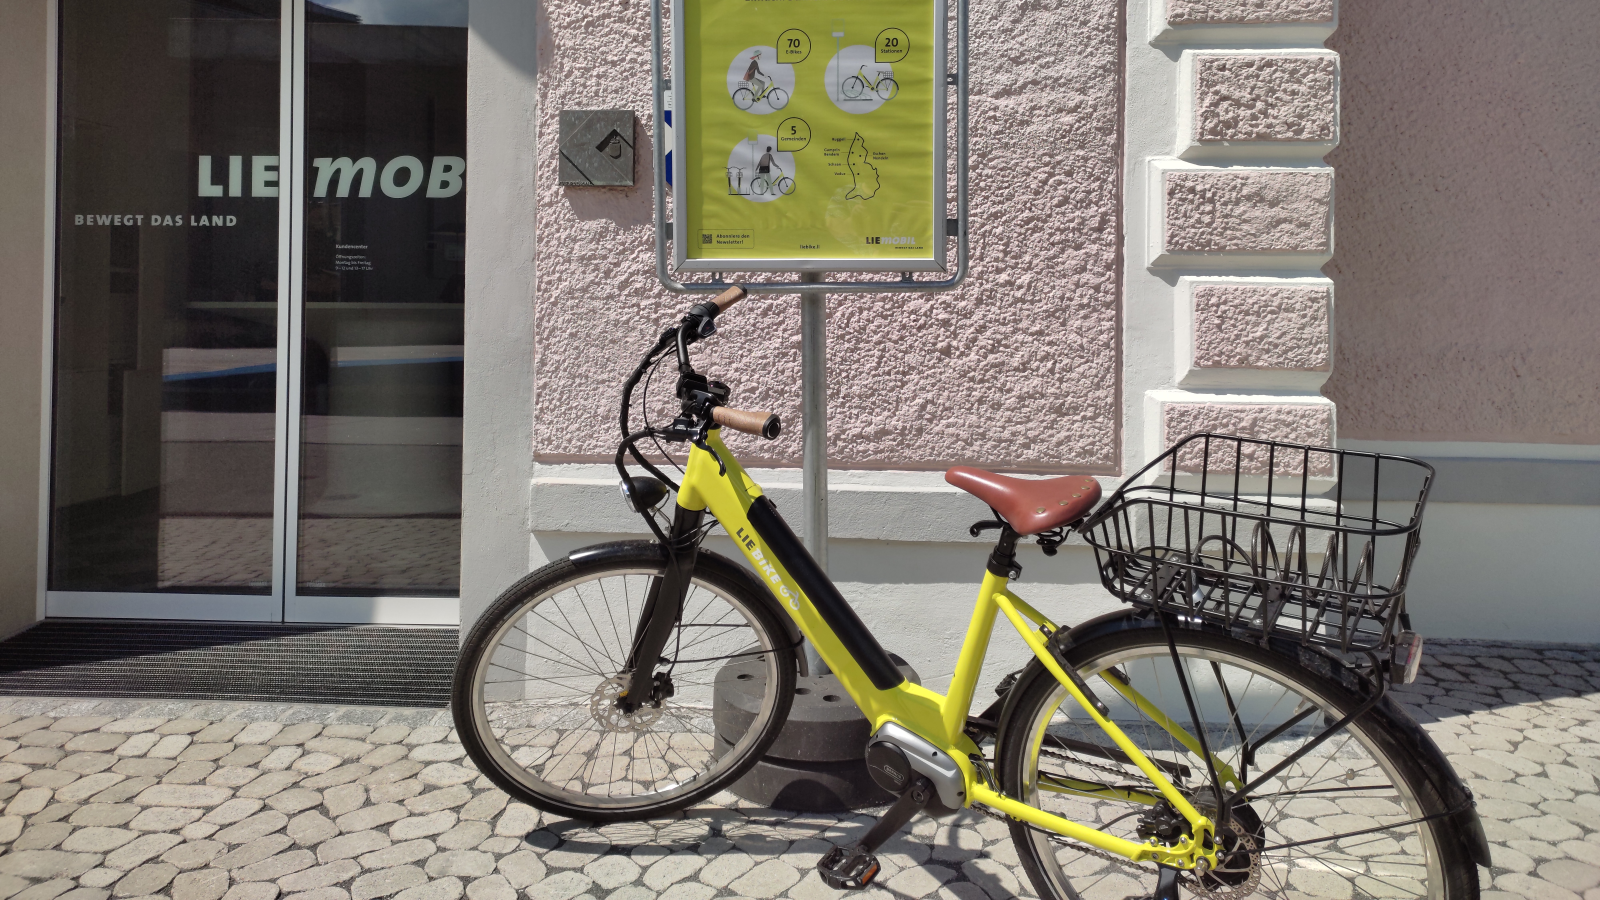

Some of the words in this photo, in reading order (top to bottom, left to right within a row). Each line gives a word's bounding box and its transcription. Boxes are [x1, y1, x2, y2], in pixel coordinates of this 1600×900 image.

[787, 38, 801, 48] 70
[884, 37, 899, 48] 20
[790, 125, 797, 135] 5
[198, 155, 280, 198] LIE
[74, 214, 144, 226] BEWEGT
[150, 214, 184, 226] DAS
[190, 215, 237, 227] LAND
